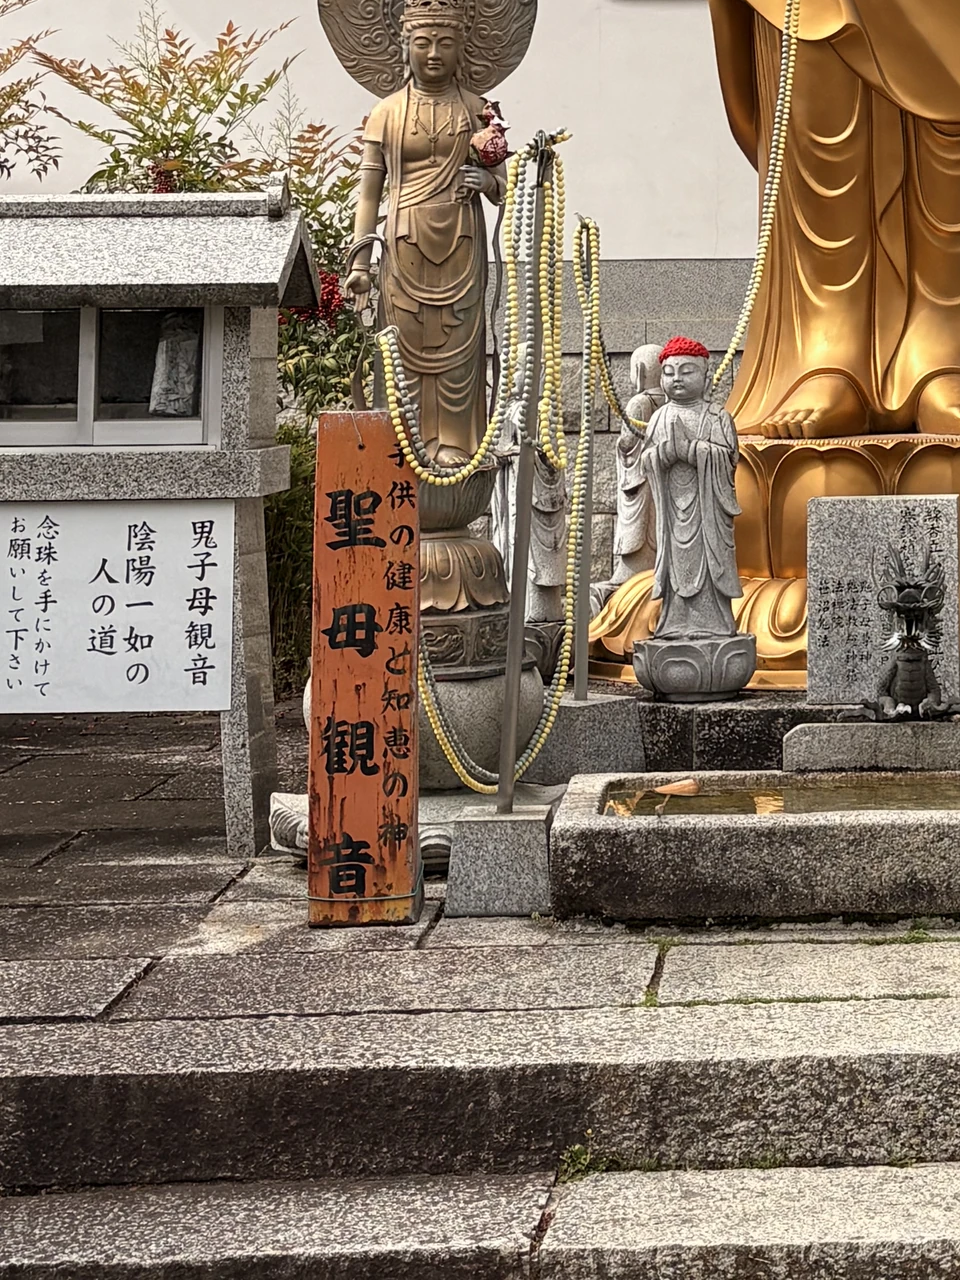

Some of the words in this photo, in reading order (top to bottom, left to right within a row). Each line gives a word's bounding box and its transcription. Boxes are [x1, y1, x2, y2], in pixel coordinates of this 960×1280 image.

[5, 517, 31, 690] お願いして下さい
[34, 515, 60, 697] 念珠を手にかけて
[87, 558, 120, 656] 人の道
[123, 521, 158, 685] 陰陽一如の
